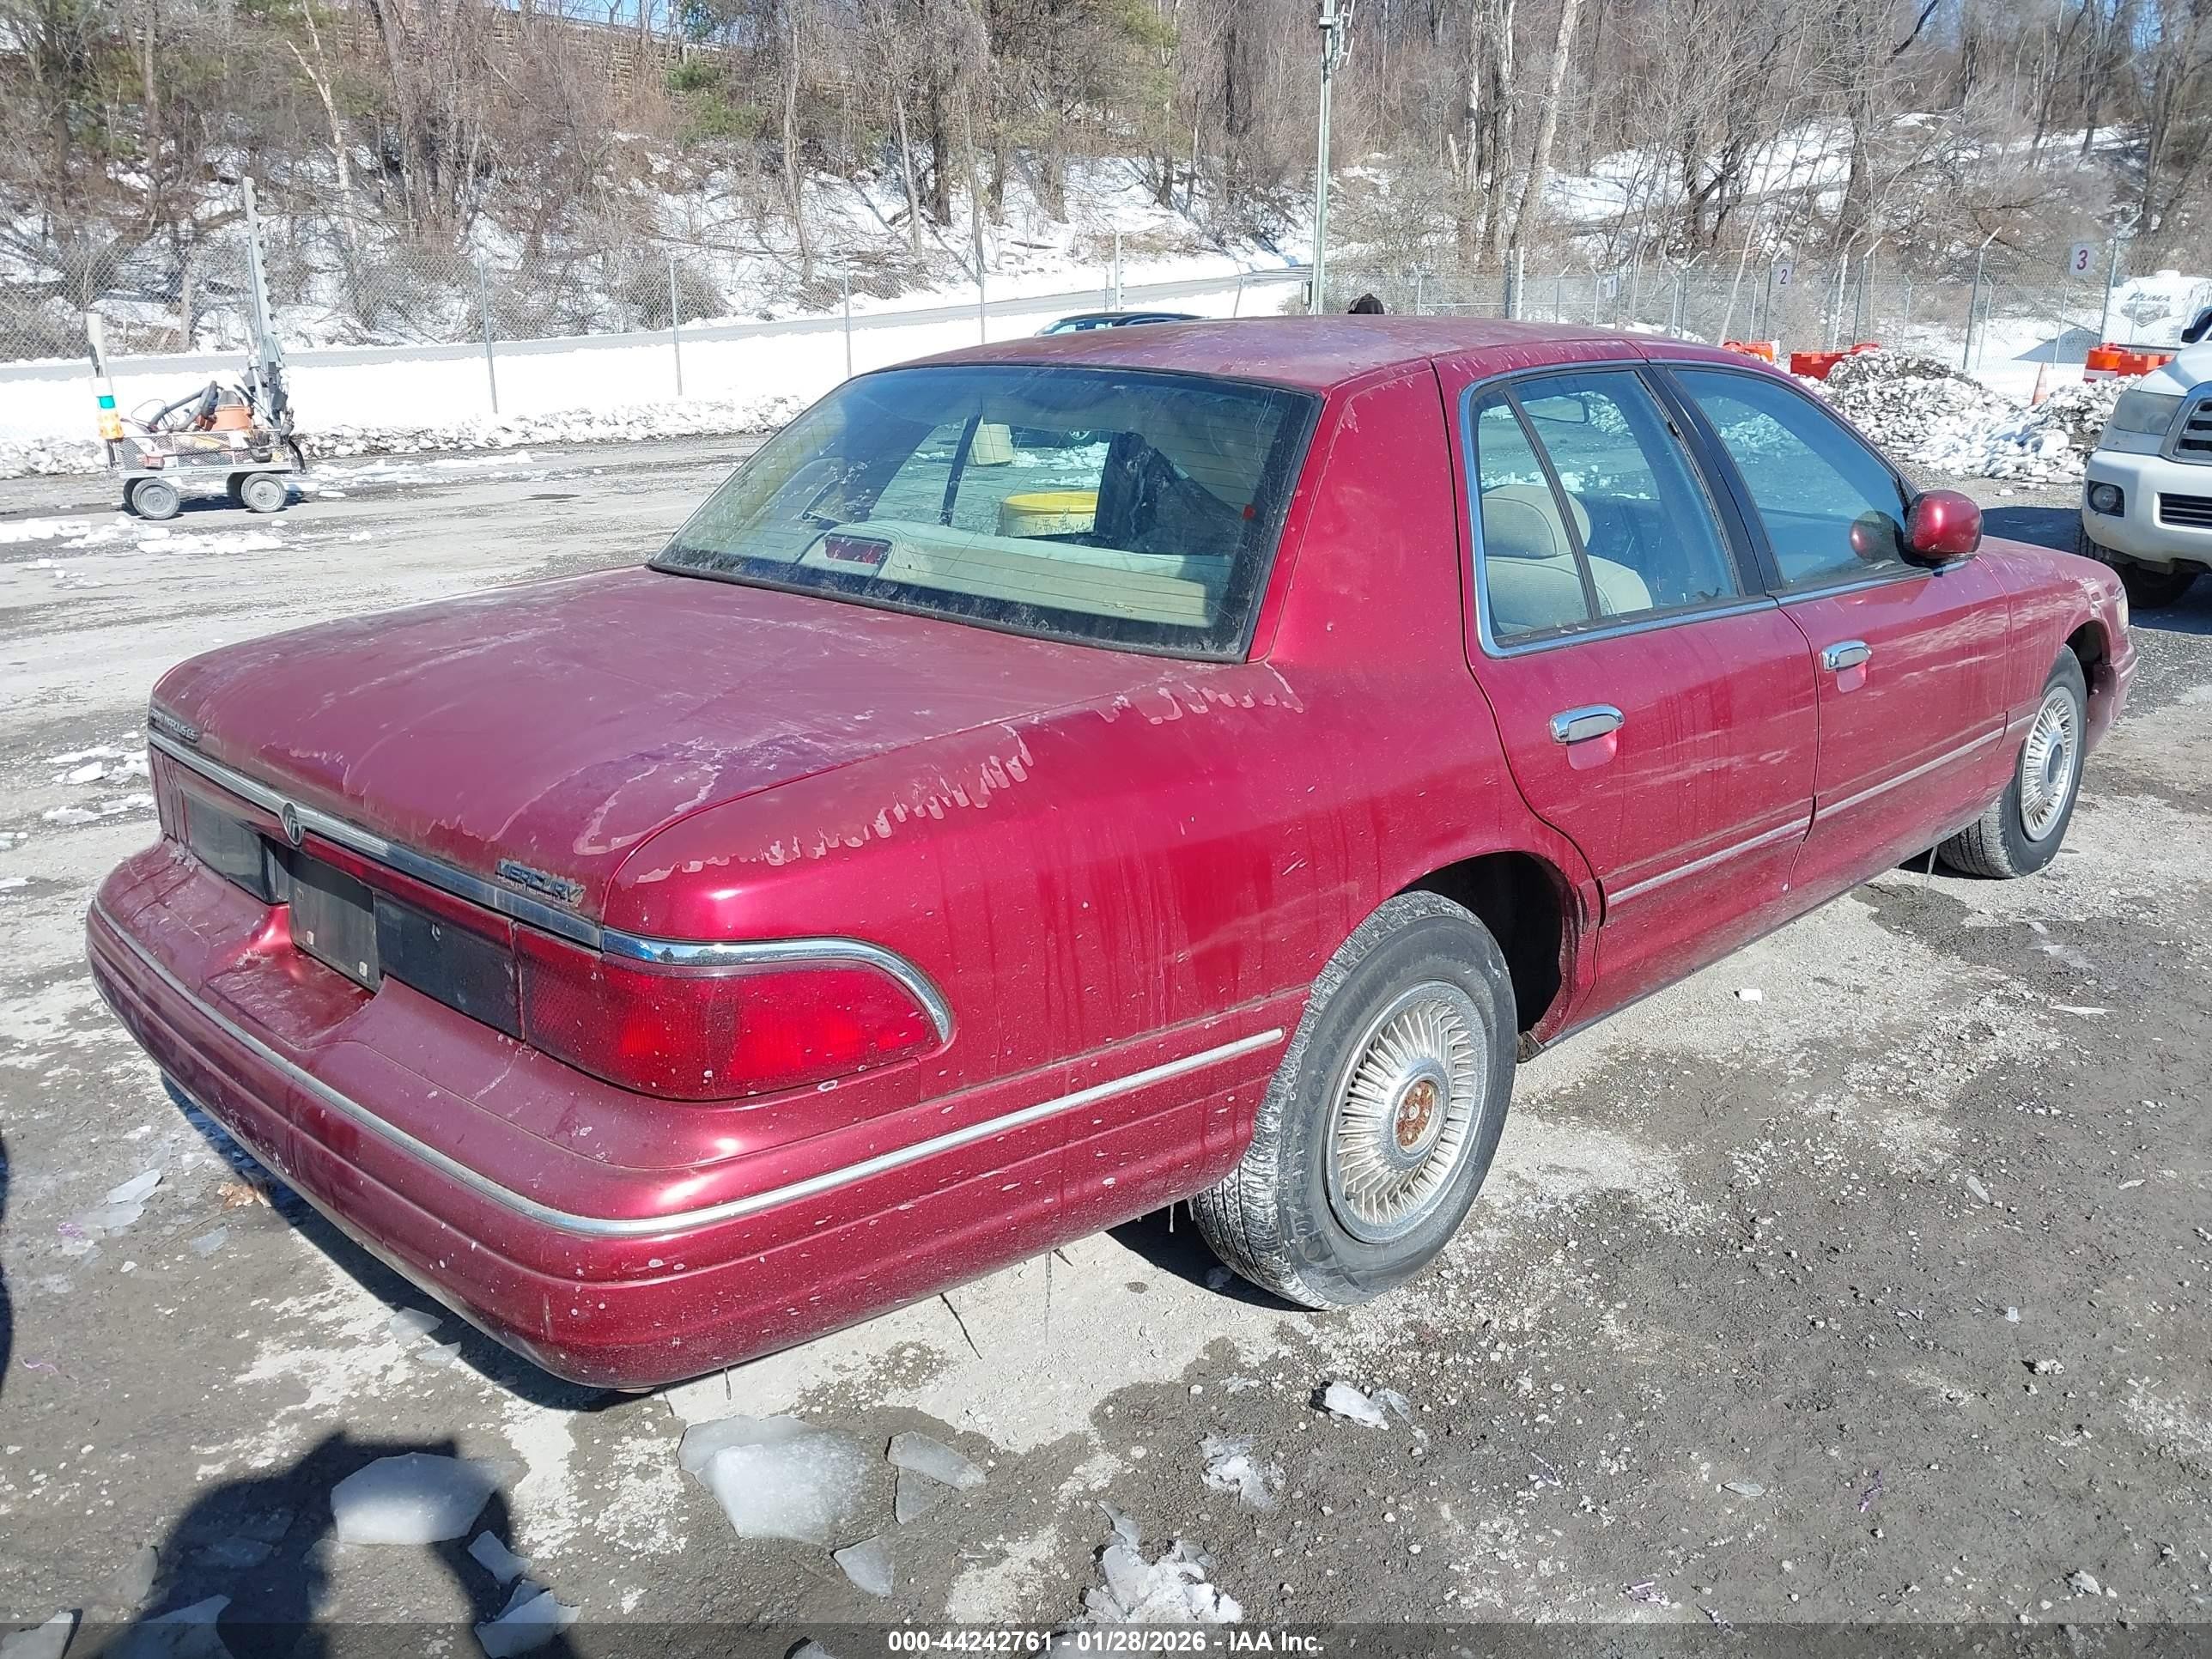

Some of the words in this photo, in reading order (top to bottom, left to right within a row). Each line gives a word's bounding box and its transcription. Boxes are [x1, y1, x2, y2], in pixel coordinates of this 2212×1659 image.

[2076, 249, 2087, 270] 3
[1779, 268, 1788, 285] 2
[495, 859, 586, 902] MERCURY
